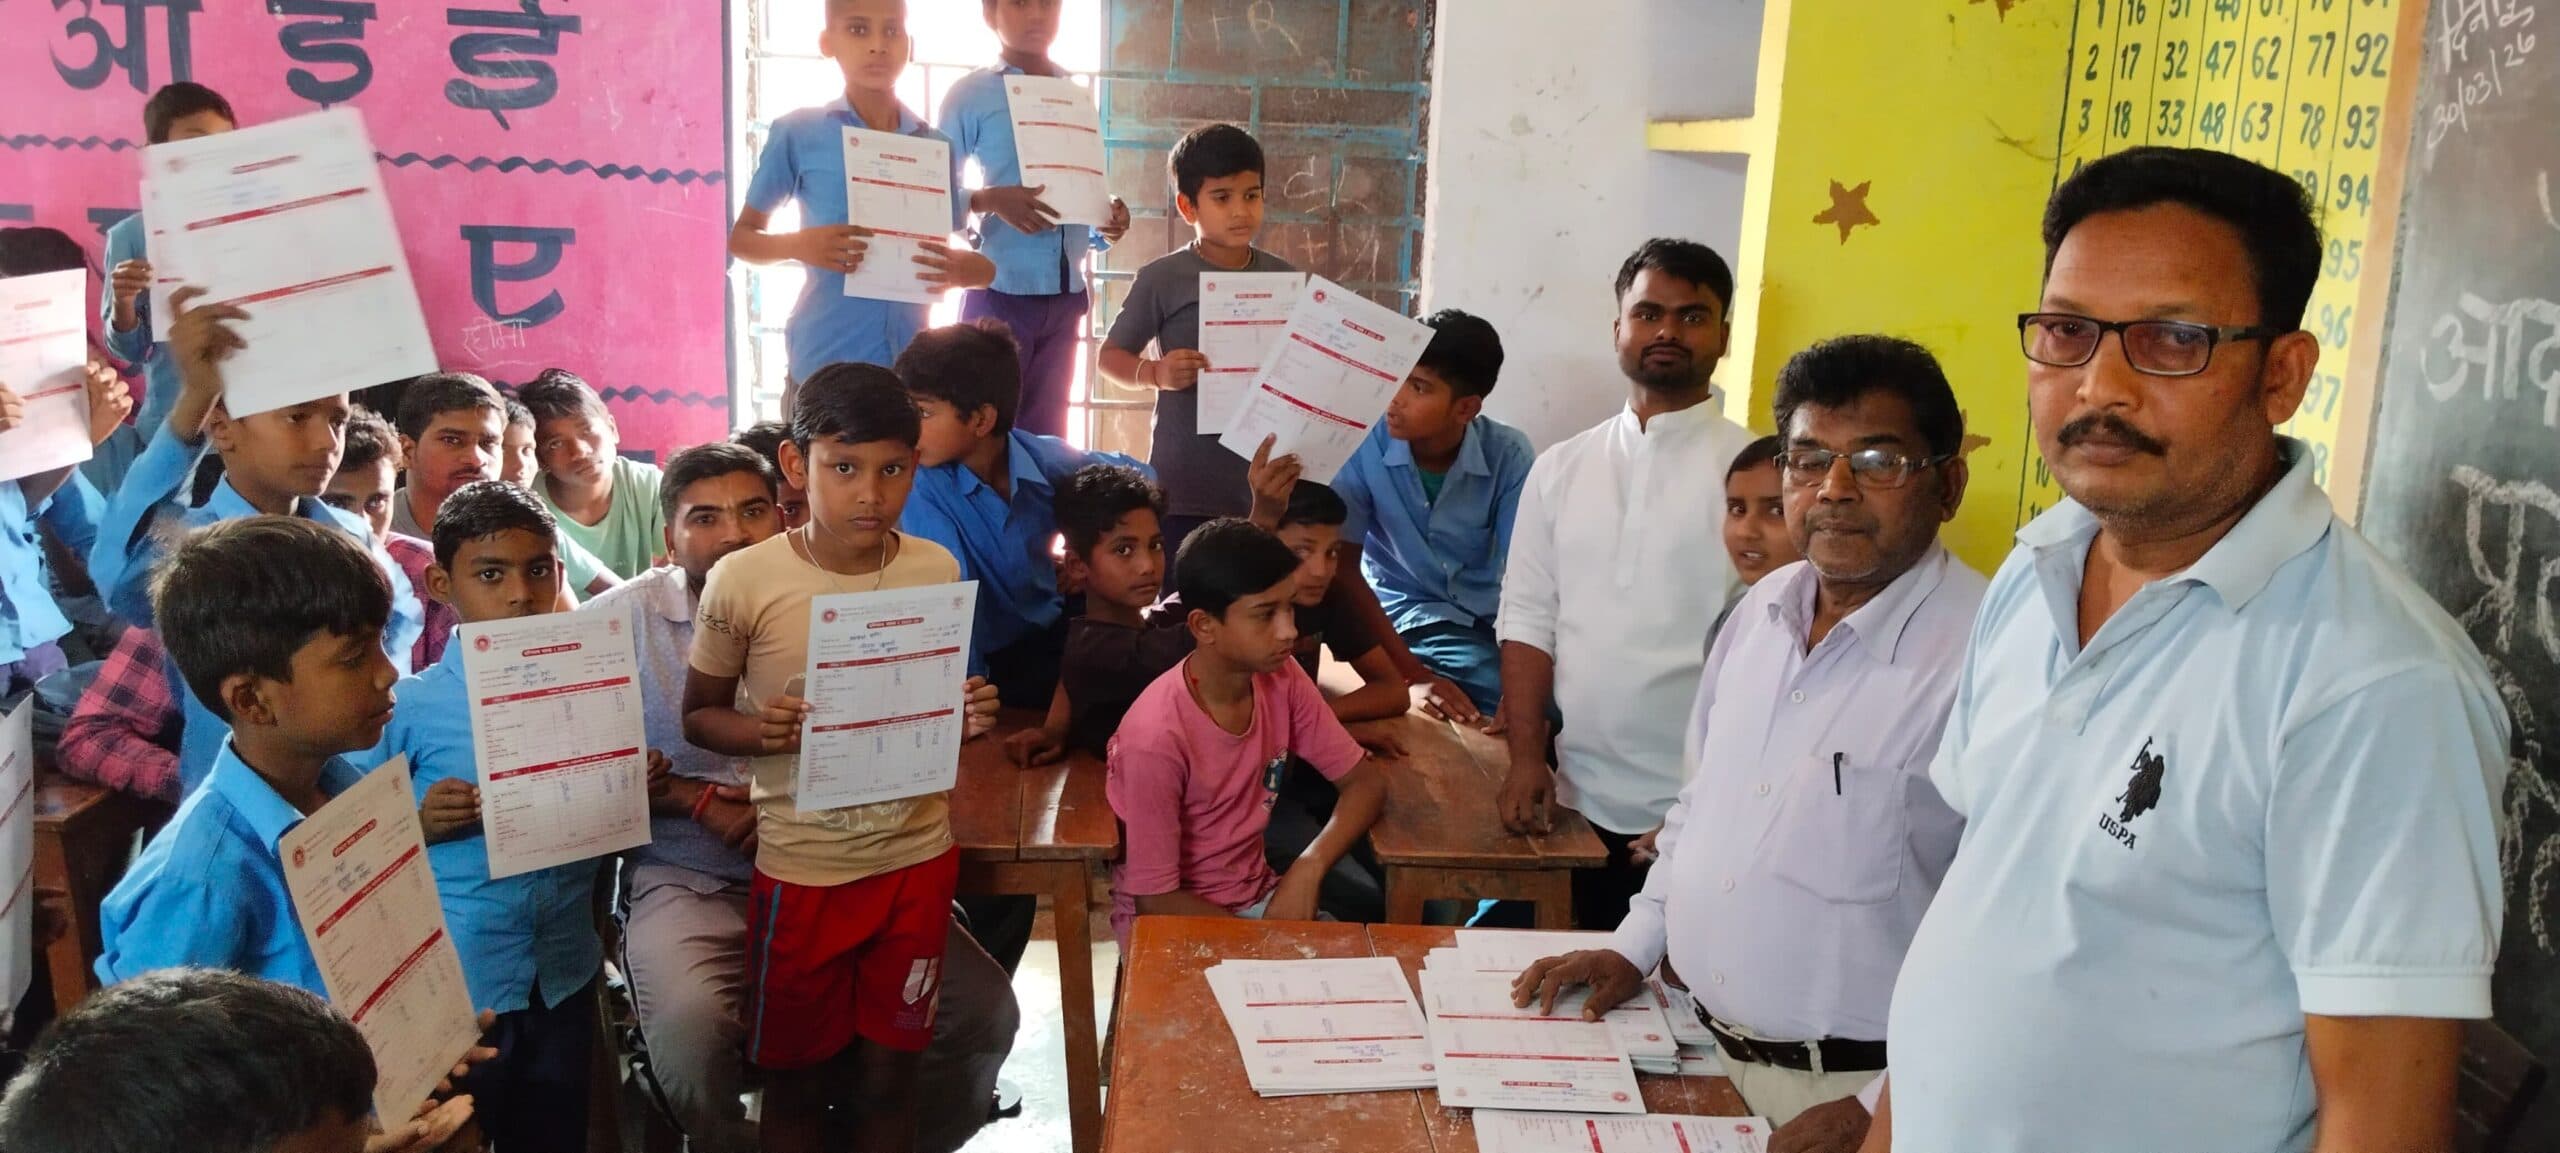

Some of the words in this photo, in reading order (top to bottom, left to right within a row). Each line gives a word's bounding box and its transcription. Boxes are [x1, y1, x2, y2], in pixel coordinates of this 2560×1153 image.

[2085, 44, 2099, 81] 2
[2121, 43, 2141, 80] 17
[2162, 40, 2188, 81] 32
[2205, 40, 2236, 82] 47
[2252, 36, 2281, 80] 62
[2308, 31, 2336, 77] 77
[2350, 32, 2389, 78] 92
[2078, 99, 2093, 134] 3
[2113, 101, 2132, 139] 18
[2157, 99, 2185, 137] 33
[2200, 102, 2226, 144] 48
[2240, 101, 2273, 142] 63
[2300, 103, 2325, 149] 78
[2343, 104, 2380, 149] 93
[2335, 173, 2371, 218] 94
[460, 225, 576, 327] ए
[2325, 238, 2362, 283] 95
[2317, 304, 2352, 349] 96
[2302, 372, 2341, 422] 97
[2099, 812, 2137, 850] USPA
